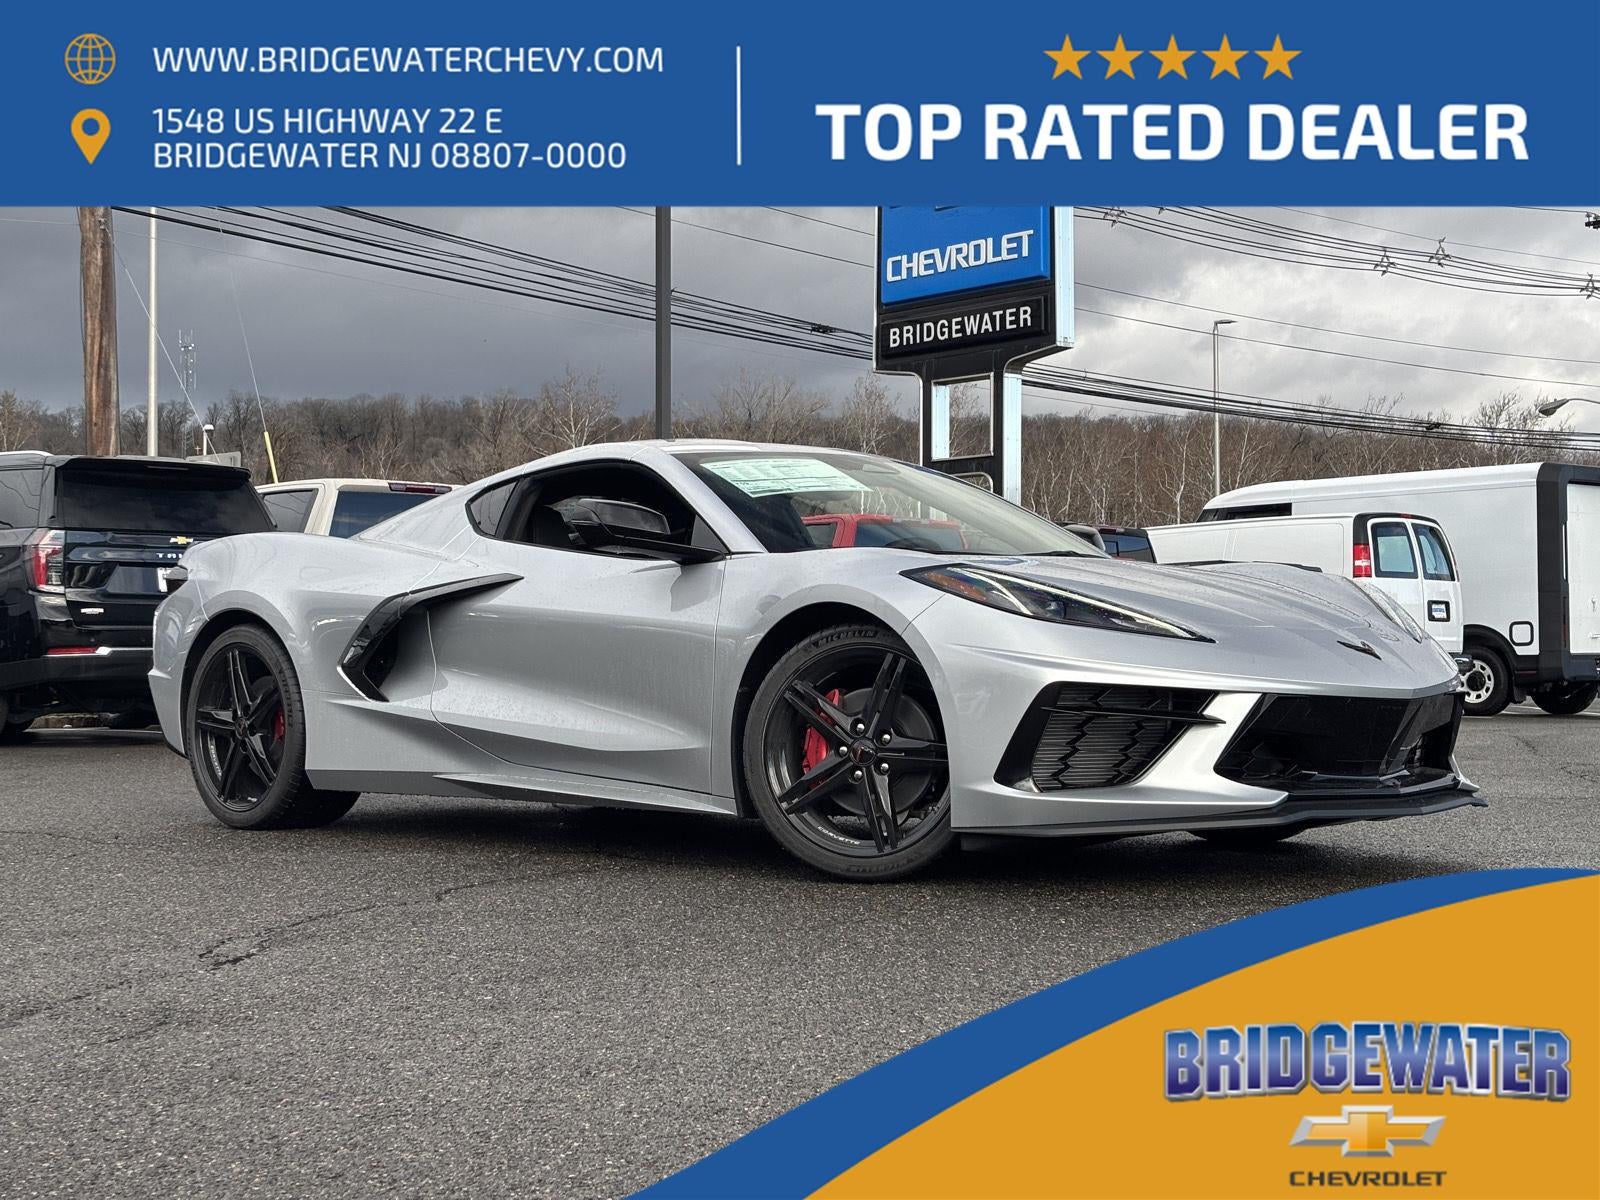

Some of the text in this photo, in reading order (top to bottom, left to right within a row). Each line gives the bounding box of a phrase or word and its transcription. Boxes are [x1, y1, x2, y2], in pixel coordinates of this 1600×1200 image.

[886, 229, 1034, 283] CHEVROLET
[889, 306, 1032, 348] BRIDGEWATER
[816, 629, 875, 648] MICHELIN
